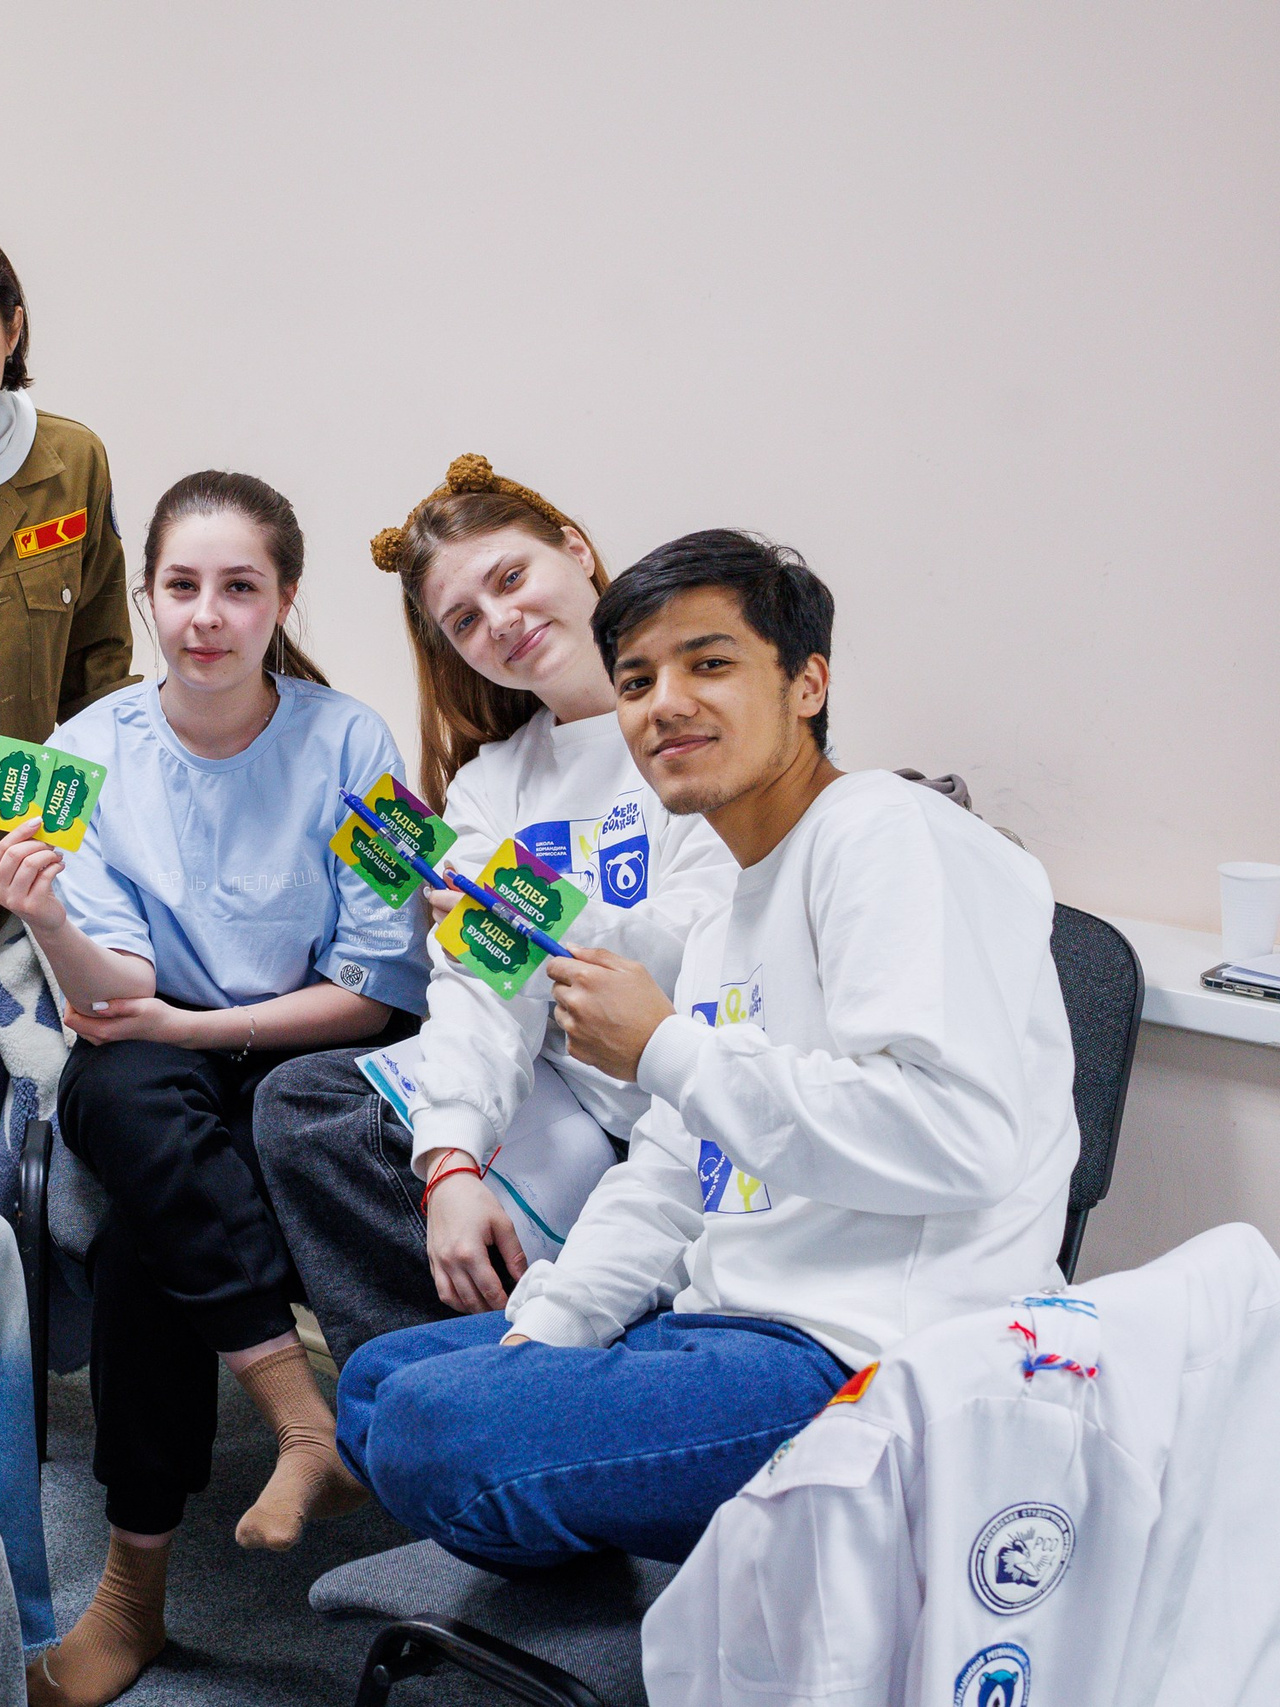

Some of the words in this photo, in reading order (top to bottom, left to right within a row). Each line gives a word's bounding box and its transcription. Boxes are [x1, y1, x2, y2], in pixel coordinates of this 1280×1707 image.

[1, 767, 19, 803] ИДЕЯ
[12, 763, 31, 812] БУДУЩЕГО
[46, 780, 67, 816] ИДЕЯ
[56, 778, 80, 826] БУДУЩЕГО
[390, 806, 424, 839] ИДЕЯ
[602, 811, 640, 835] ВОЛНУЕТ
[608, 802, 638, 820] МЕНЯ
[378, 811, 420, 852] БУДУЩЕГО
[355, 839, 397, 881] БУДУЩЕГО
[368, 836, 398, 867] ИДЕЯ
[230, 869, 320, 894] ДЕЛАЕШЬ
[511, 875, 549, 907] ИДЕЯ
[497, 882, 545, 924] БУДУЩЕГО
[465, 924, 512, 965] БУДУЩЕГО
[479, 917, 516, 951] ИДЕЯ
